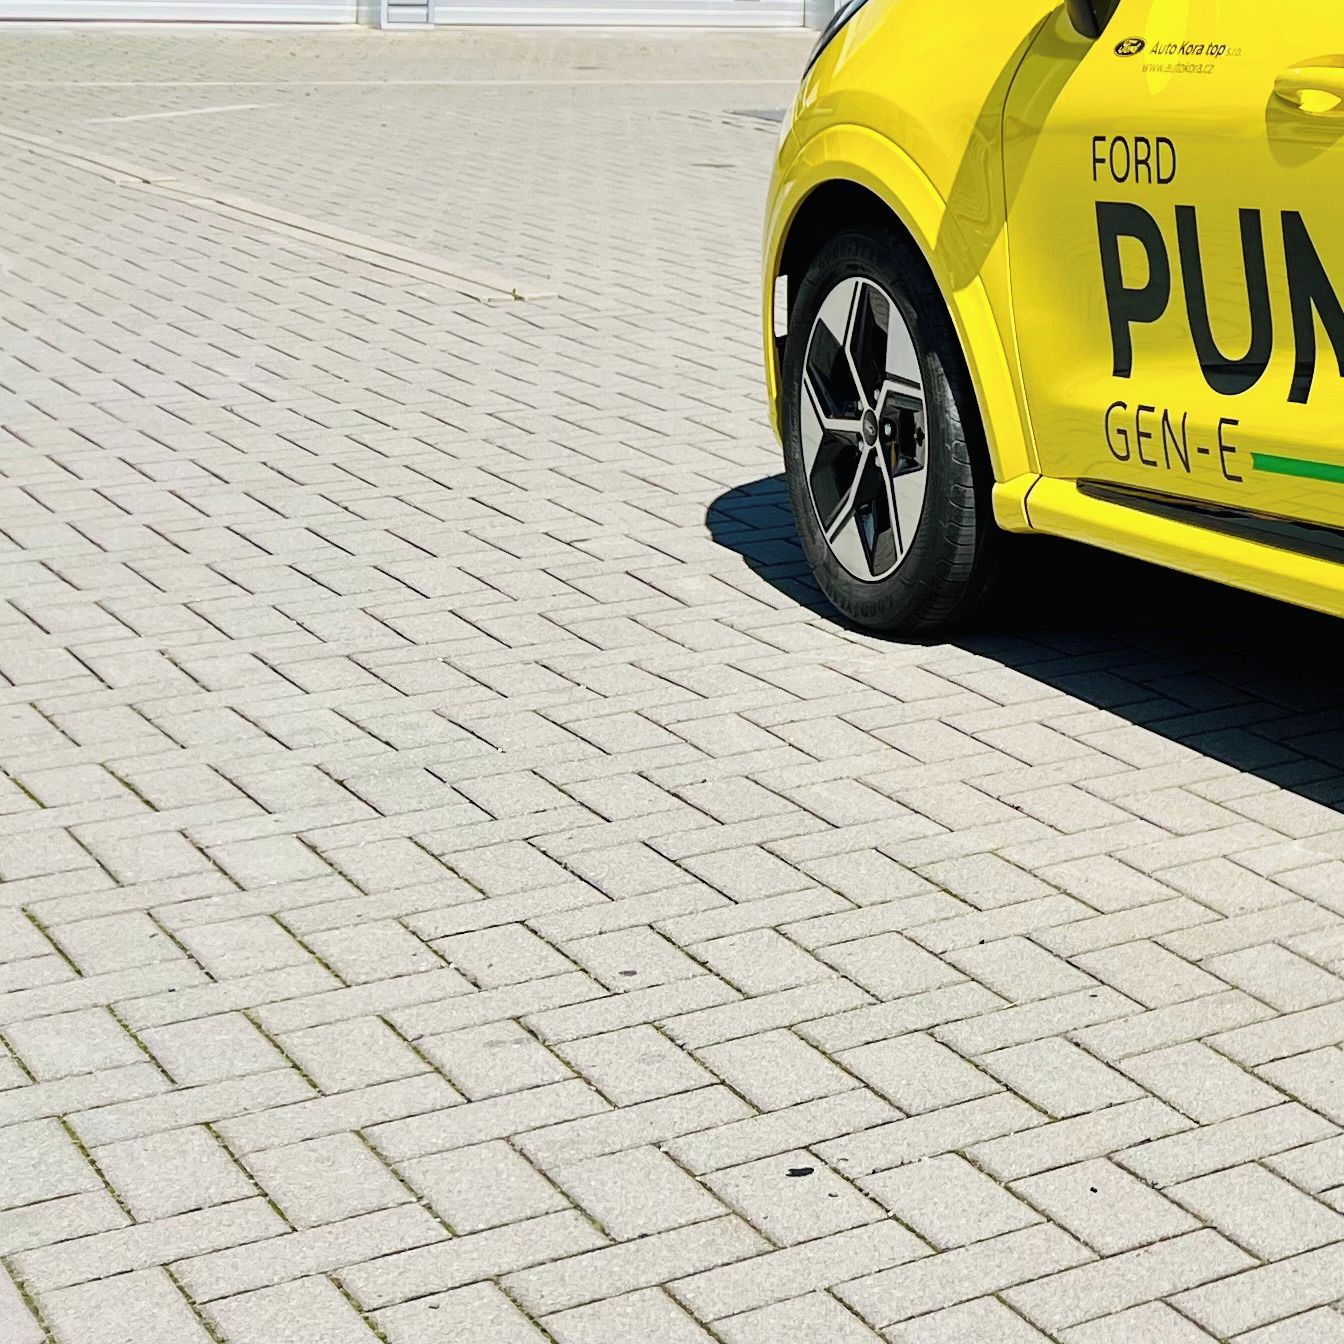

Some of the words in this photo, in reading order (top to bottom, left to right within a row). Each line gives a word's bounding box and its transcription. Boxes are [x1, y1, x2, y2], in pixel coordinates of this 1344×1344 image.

[1150, 40, 1177, 56] Auto
[1177, 40, 1205, 56] Kora
[1205, 42, 1226, 58] top
[1091, 134, 1177, 185] FORD
[1104, 400, 1244, 483] GEN-E
